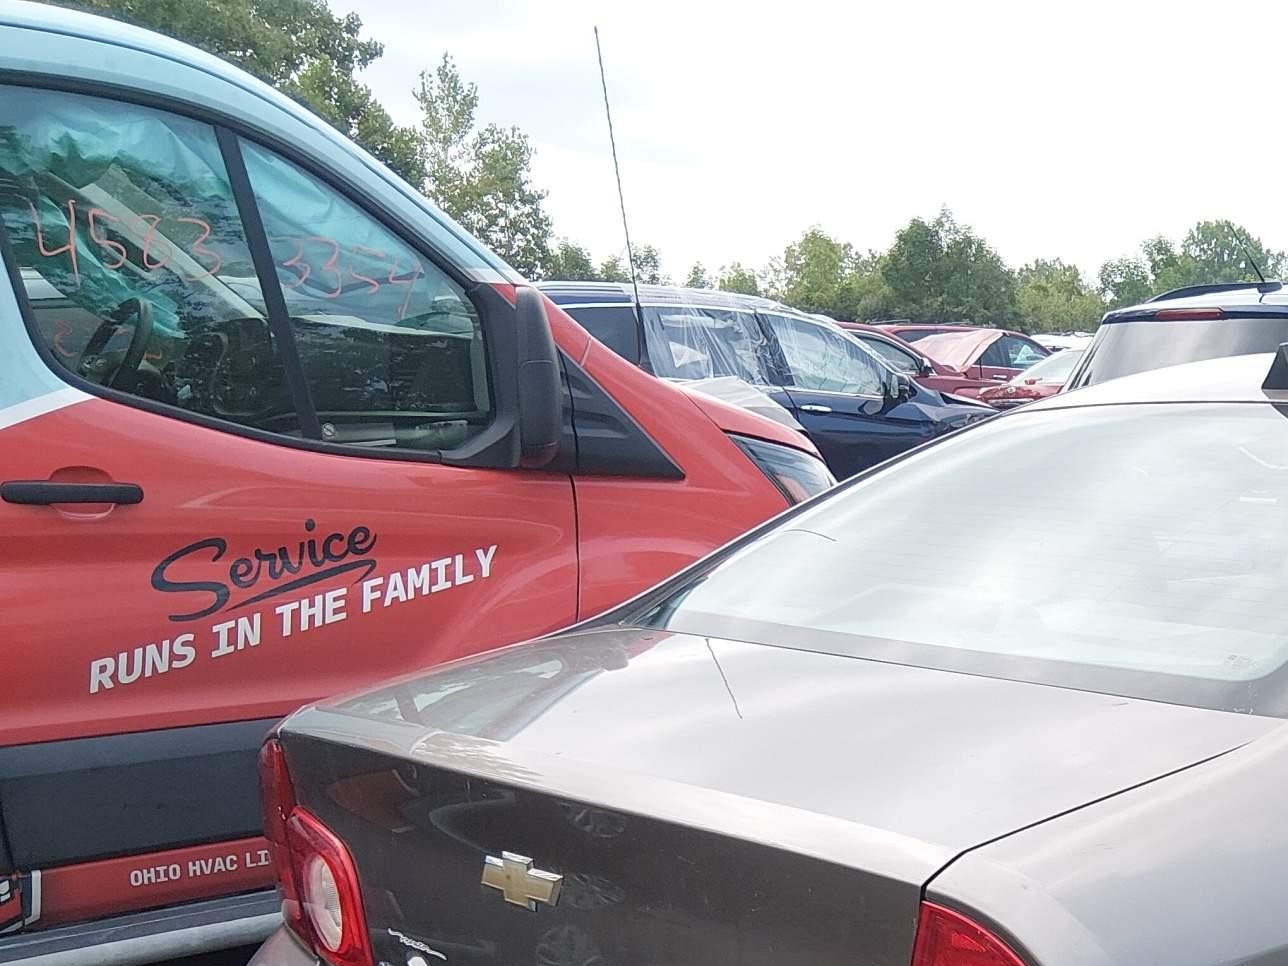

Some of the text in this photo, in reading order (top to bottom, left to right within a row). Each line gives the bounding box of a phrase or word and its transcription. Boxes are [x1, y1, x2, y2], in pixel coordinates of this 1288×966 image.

[89, 544, 498, 694] RUNS IN THE FAMILY
[151, 518, 377, 622] Service
[130, 849, 271, 887] OHIO HVAC LI
